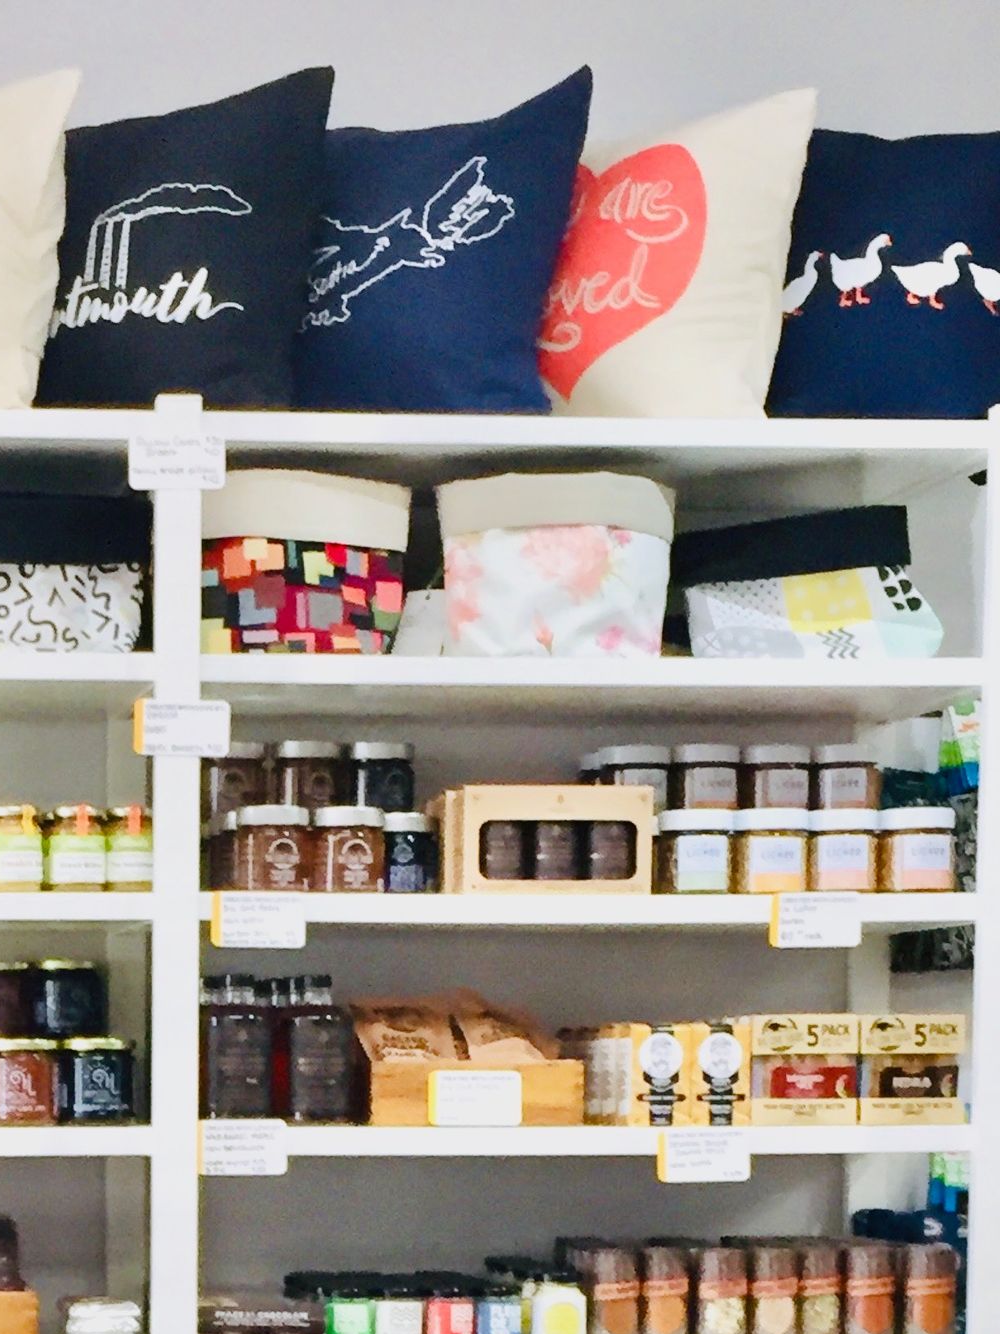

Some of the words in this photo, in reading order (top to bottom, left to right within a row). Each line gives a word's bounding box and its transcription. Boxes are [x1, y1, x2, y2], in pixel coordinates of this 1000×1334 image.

[600, 176, 689, 243] are
[548, 243, 662, 317] ved
[806, 1024, 819, 1047] 5
[821, 1023, 850, 1036] PACK
[914, 1023, 928, 1047] 5
[929, 1023, 958, 1036] PACK
